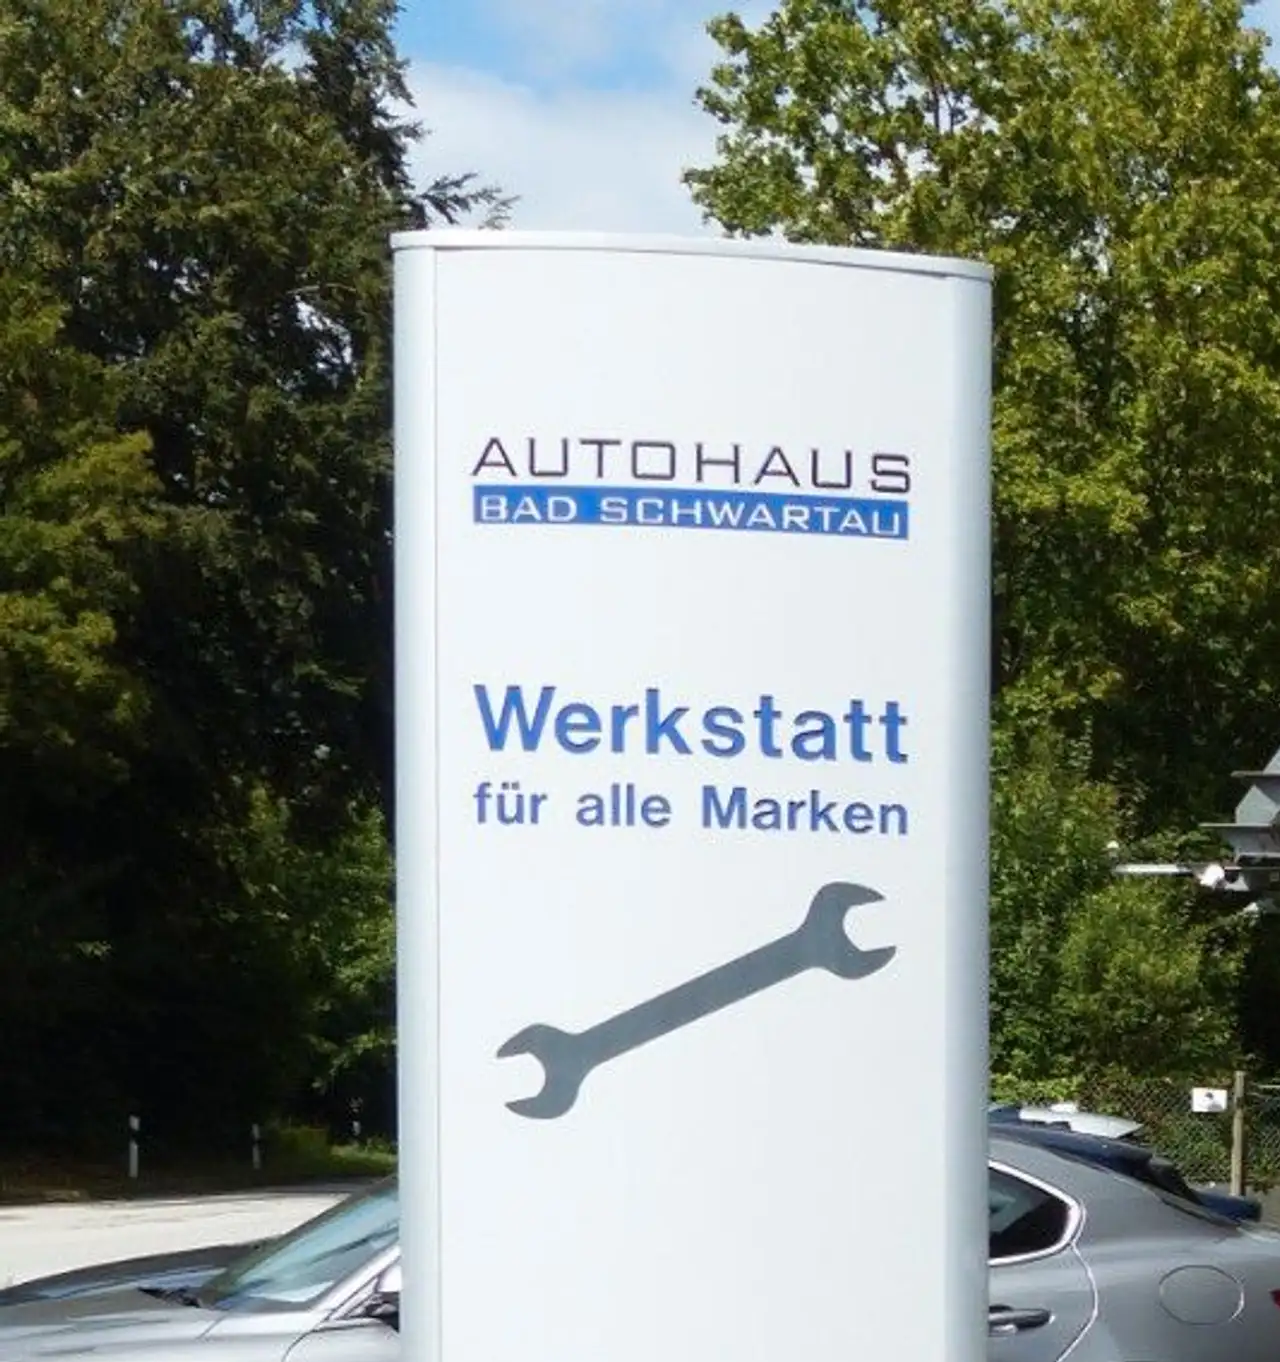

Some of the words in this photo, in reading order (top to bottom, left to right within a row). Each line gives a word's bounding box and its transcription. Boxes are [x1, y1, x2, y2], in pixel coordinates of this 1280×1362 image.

[472, 437, 911, 494] AUTOHAUS
[480, 495, 577, 523] BAD
[600, 497, 901, 536] SCHWARTAU
[473, 684, 908, 764] Werkstatt
[473, 781, 548, 826] für
[575, 783, 671, 828] alle
[702, 785, 908, 835] Marken
